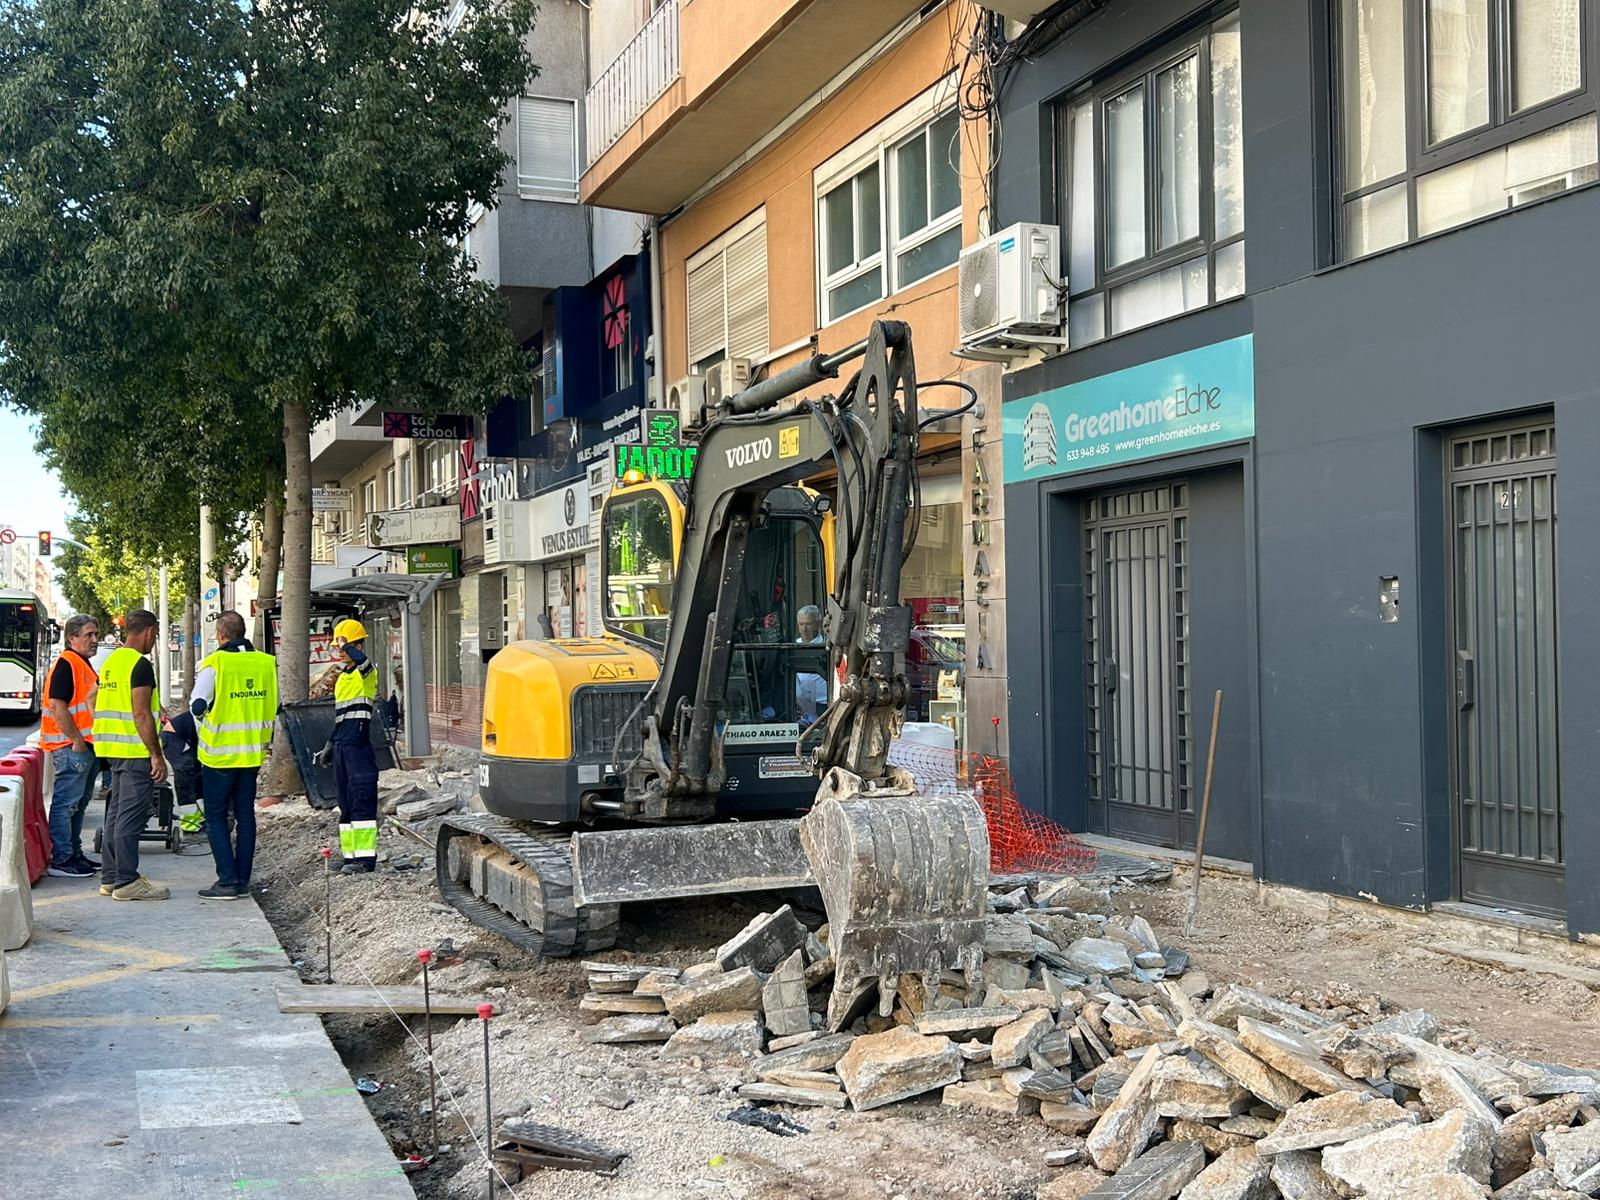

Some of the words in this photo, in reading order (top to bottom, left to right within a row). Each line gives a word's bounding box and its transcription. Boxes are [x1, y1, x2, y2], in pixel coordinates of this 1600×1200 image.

[411, 425, 458, 438] school
[1066, 449, 1080, 461] 633
[1080, 446, 1095, 459] 948
[1096, 443, 1110, 455] 495
[1115, 422, 1221, 451] www.greenhomeelche.es
[725, 437, 772, 469] VOLVO
[480, 458, 519, 502] school
[542, 531, 566, 555] VENUS
[726, 730, 758, 738] THIAGO
[759, 729, 786, 738] ARAEZ
[788, 729, 798, 737] 30
